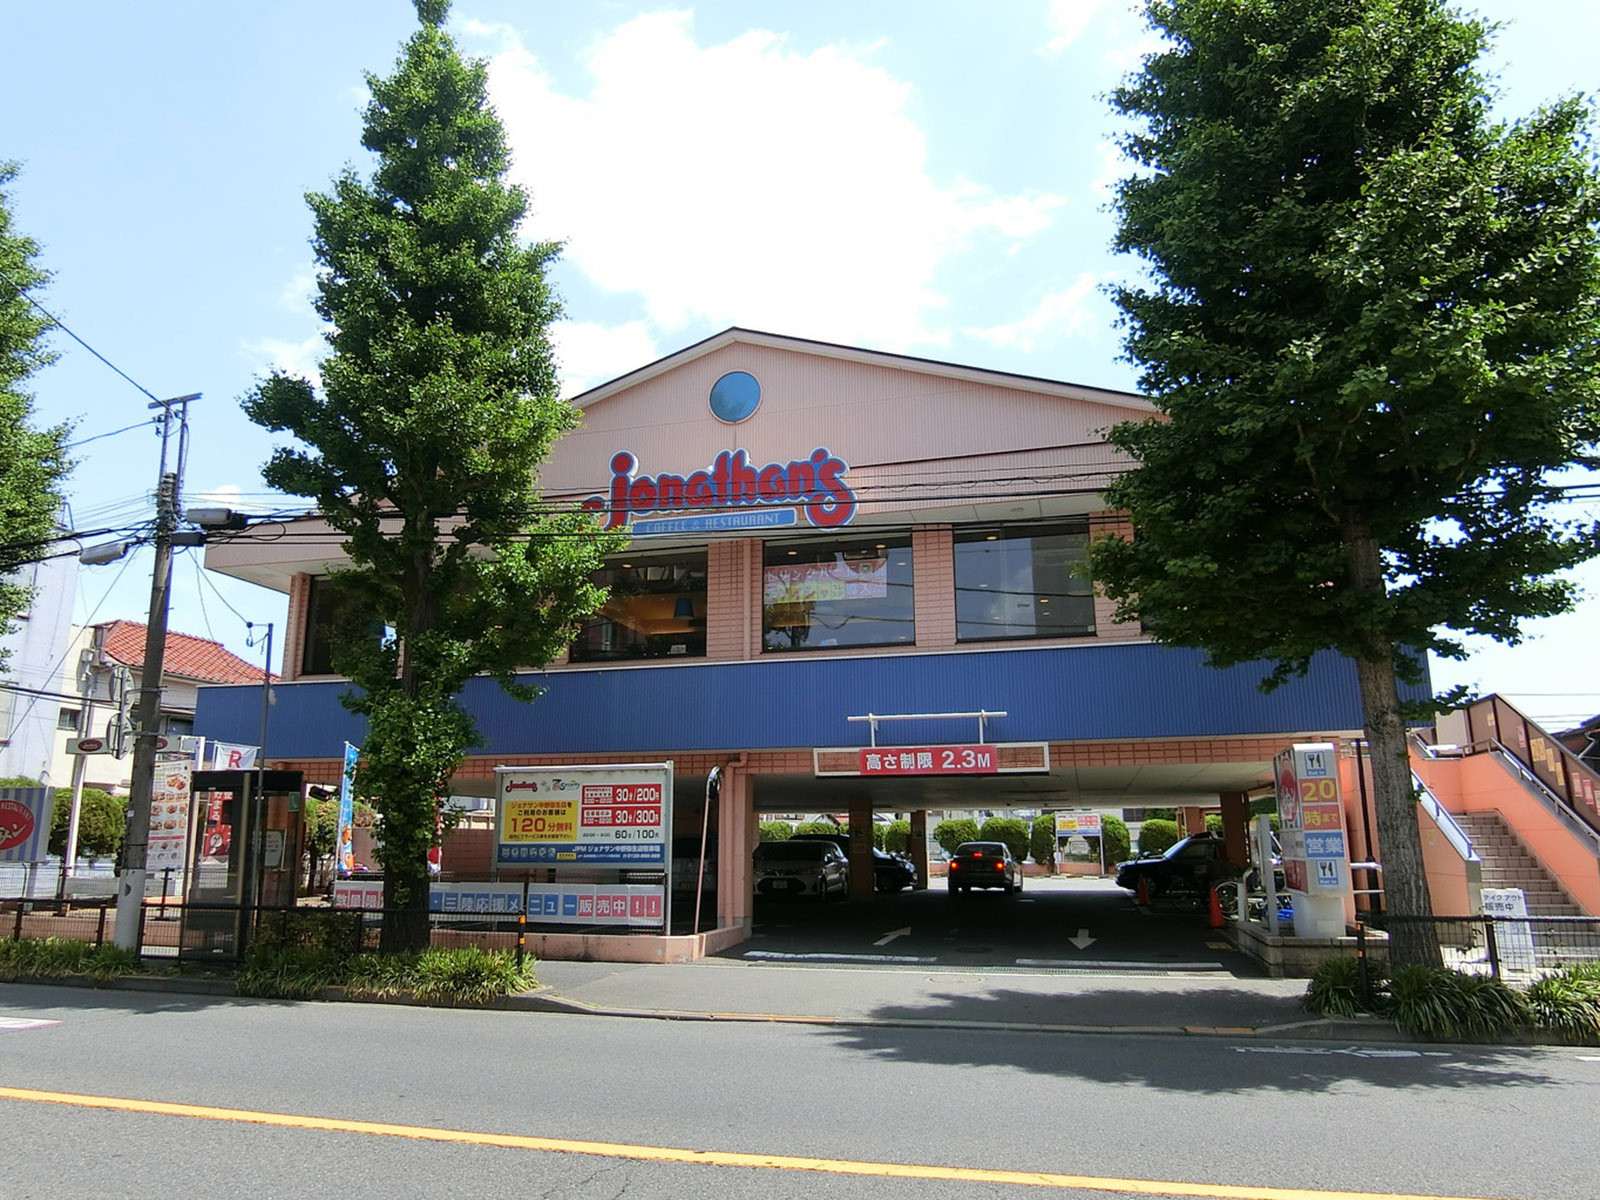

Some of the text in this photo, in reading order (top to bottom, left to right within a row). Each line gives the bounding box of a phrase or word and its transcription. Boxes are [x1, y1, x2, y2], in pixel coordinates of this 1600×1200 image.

[705, 512, 781, 528] RESTAURANT
[228, 750, 242, 768] R
[865, 749, 991, 771] 高さ制限 2.3M
[1302, 779, 1336, 802] 20
[1304, 810, 1338, 827] 時まで
[1306, 837, 1343, 854] 営業
[336, 892, 384, 908] 数量限
[1485, 903, 1514, 911] 販売中
